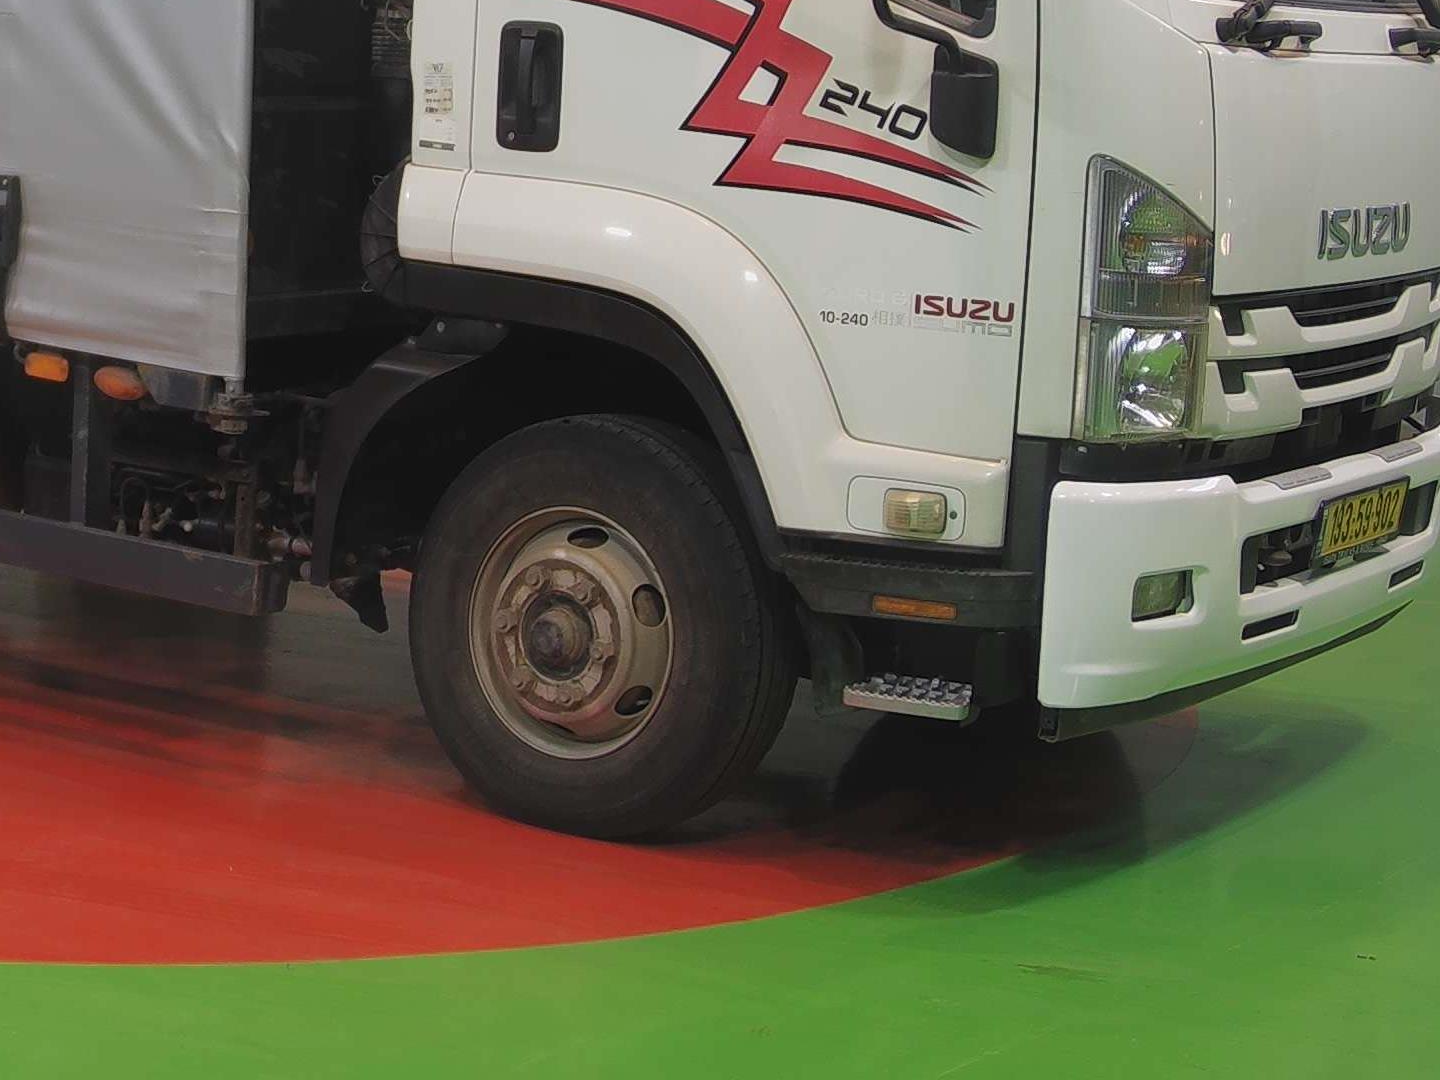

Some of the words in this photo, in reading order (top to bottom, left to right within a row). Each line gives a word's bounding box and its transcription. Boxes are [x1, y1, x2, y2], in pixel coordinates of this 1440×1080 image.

[818, 78, 928, 140] 240
[1316, 202, 1410, 261] ISUZU
[819, 310, 869, 327] 10-240
[915, 294, 1015, 323] ISUZU
